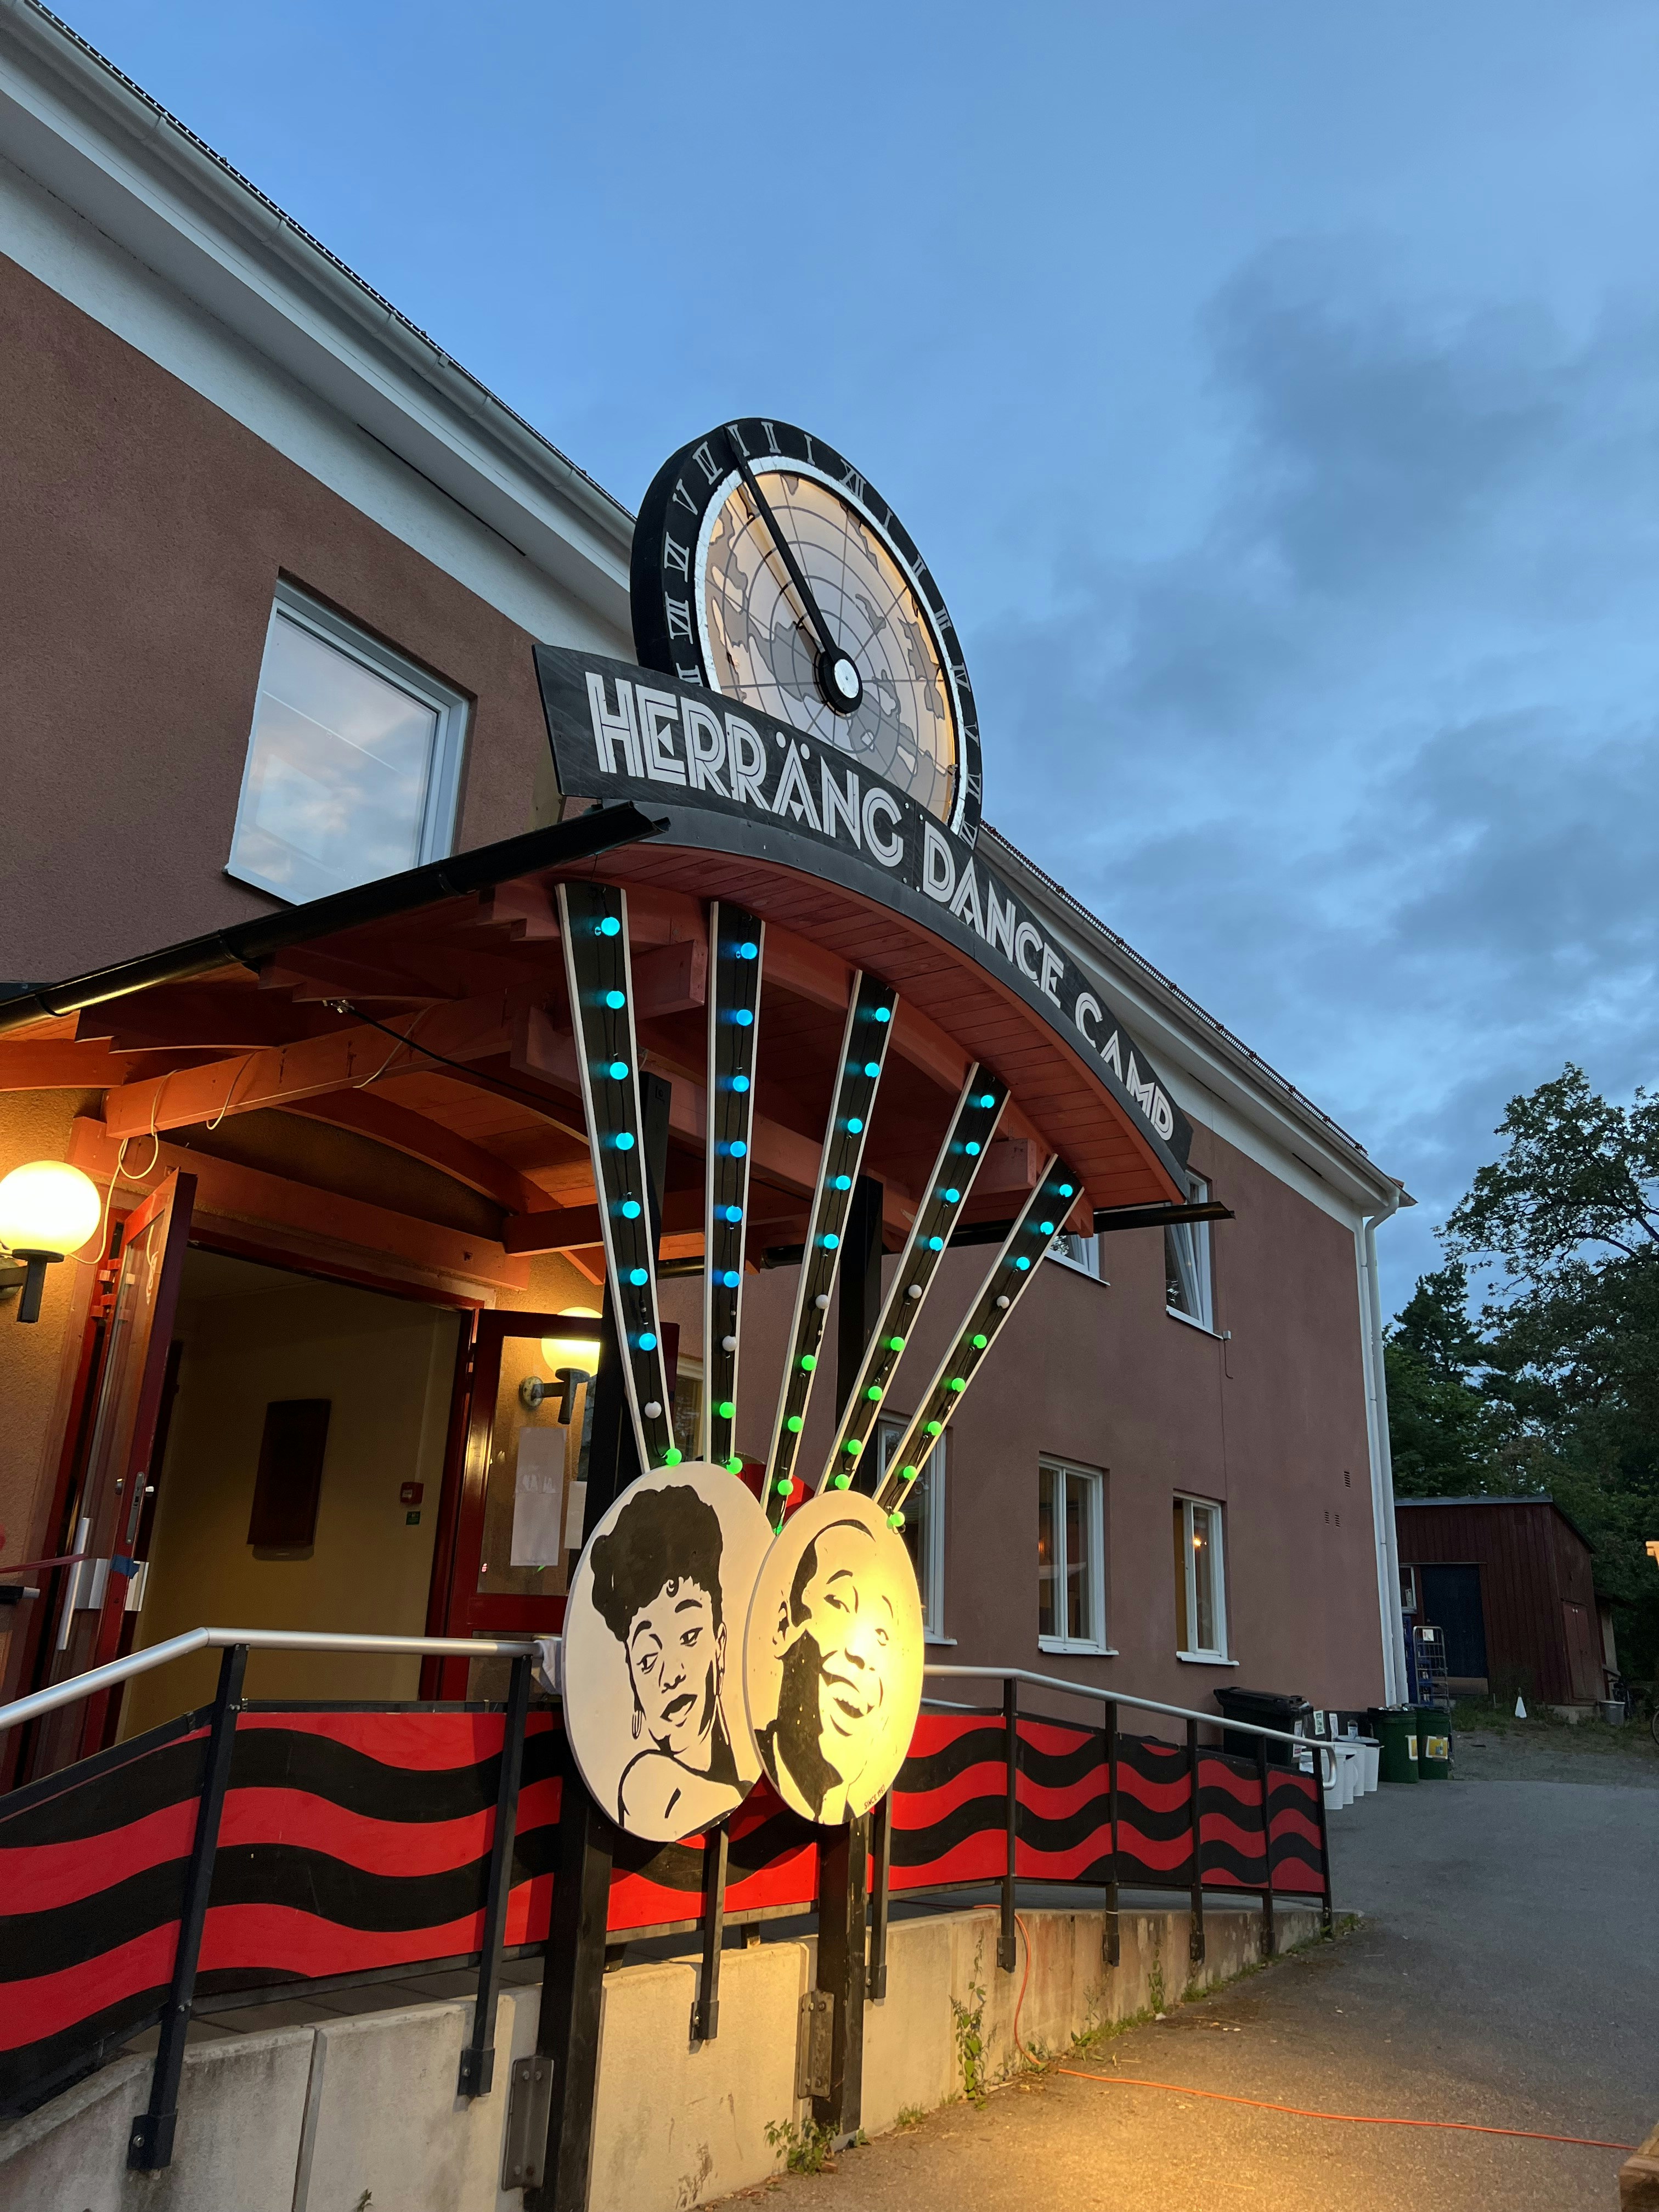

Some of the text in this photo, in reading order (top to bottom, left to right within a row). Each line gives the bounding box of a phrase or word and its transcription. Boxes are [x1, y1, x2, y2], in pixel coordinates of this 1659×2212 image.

[672, 478, 698, 516] V
[839, 459, 866, 504] XII
[585, 671, 1173, 1141] HERRÄNG DANCE CAMP
[864, 1794, 877, 1809] SINCE
